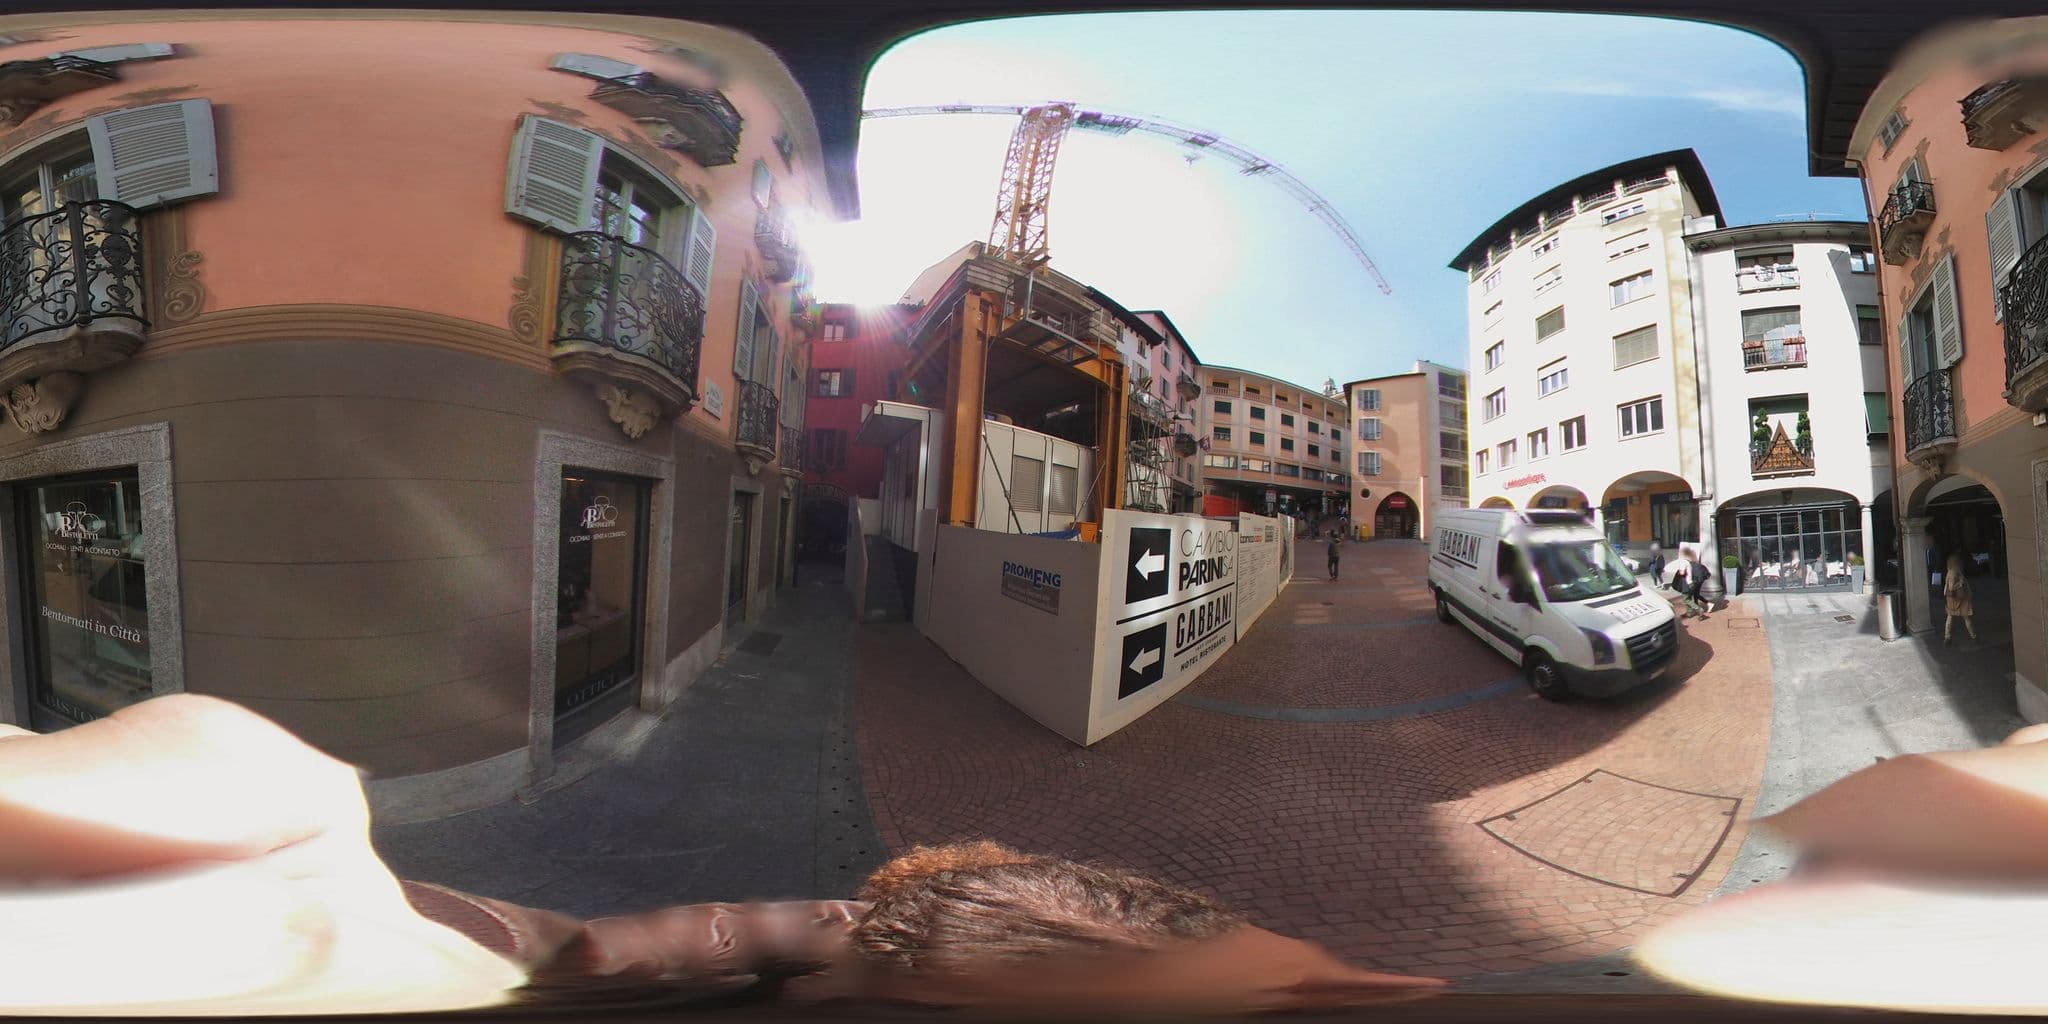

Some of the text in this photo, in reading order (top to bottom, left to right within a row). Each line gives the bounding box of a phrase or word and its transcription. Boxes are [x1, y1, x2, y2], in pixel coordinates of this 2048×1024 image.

[89, 547, 120, 557] CONTATTO
[1180, 529, 1233, 557] CAMBIO
[1002, 561, 1061, 588] PROMENG
[41, 605, 142, 643] Bentornati in Città
[1176, 591, 1232, 649] GABBANI
[1180, 655, 1199, 673] HOTEL
[1200, 635, 1227, 658] RISTORANTE
